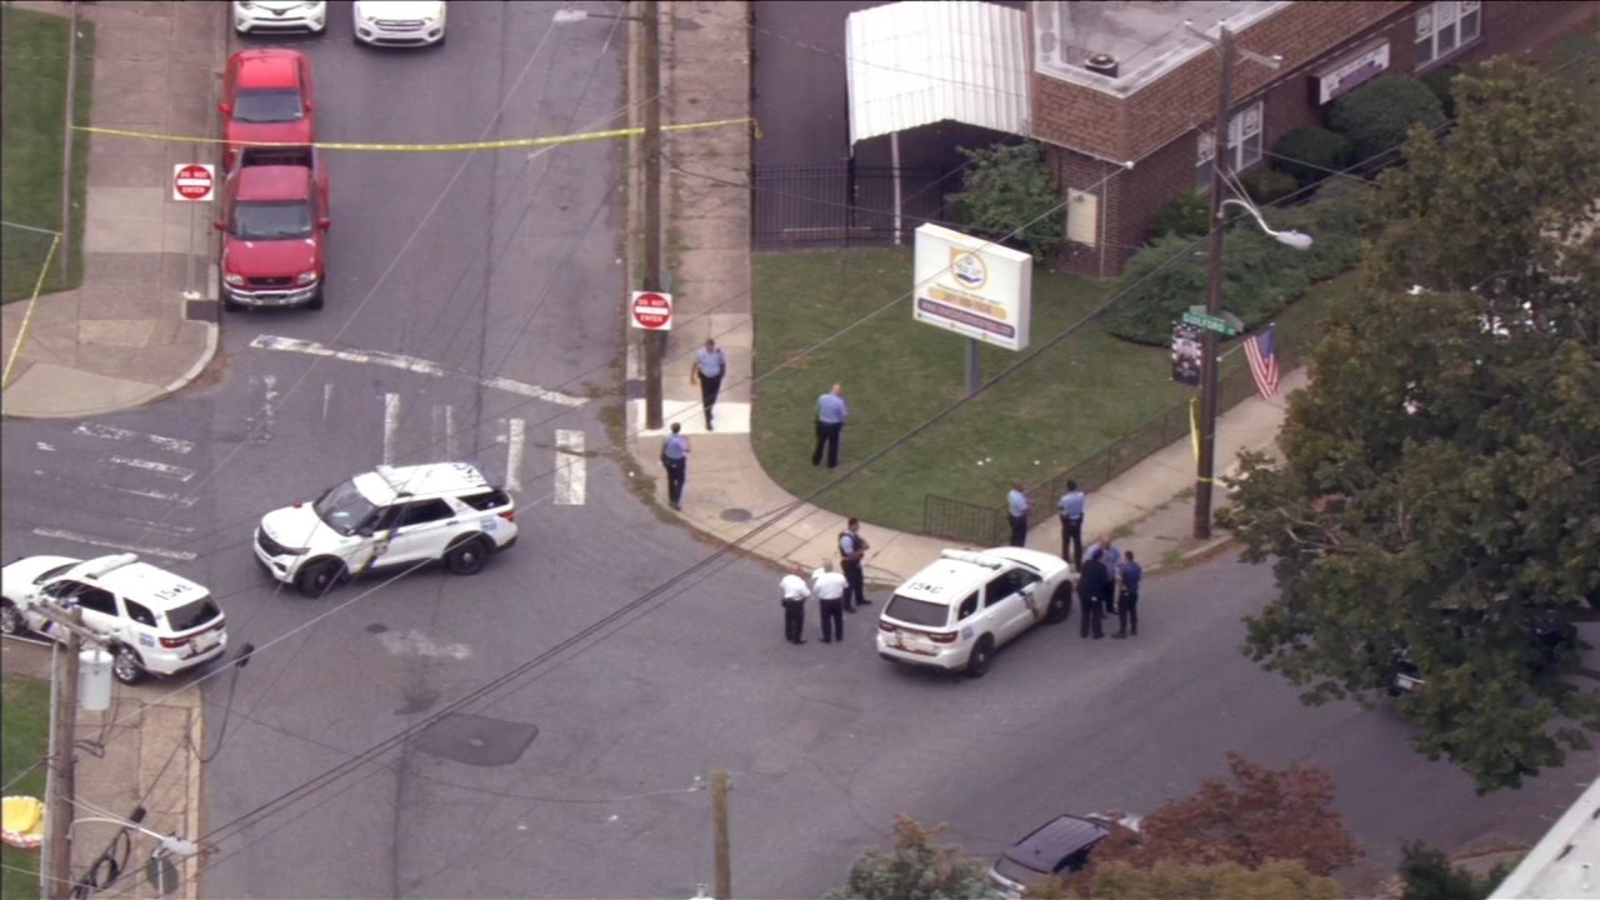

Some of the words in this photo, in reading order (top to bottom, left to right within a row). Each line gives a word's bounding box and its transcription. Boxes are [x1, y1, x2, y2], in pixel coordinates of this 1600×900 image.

[193, 170, 207, 178] NOT
[181, 186, 206, 194] ENTER
[651, 299, 666, 307] NOT
[640, 314, 663, 323] ENTER
